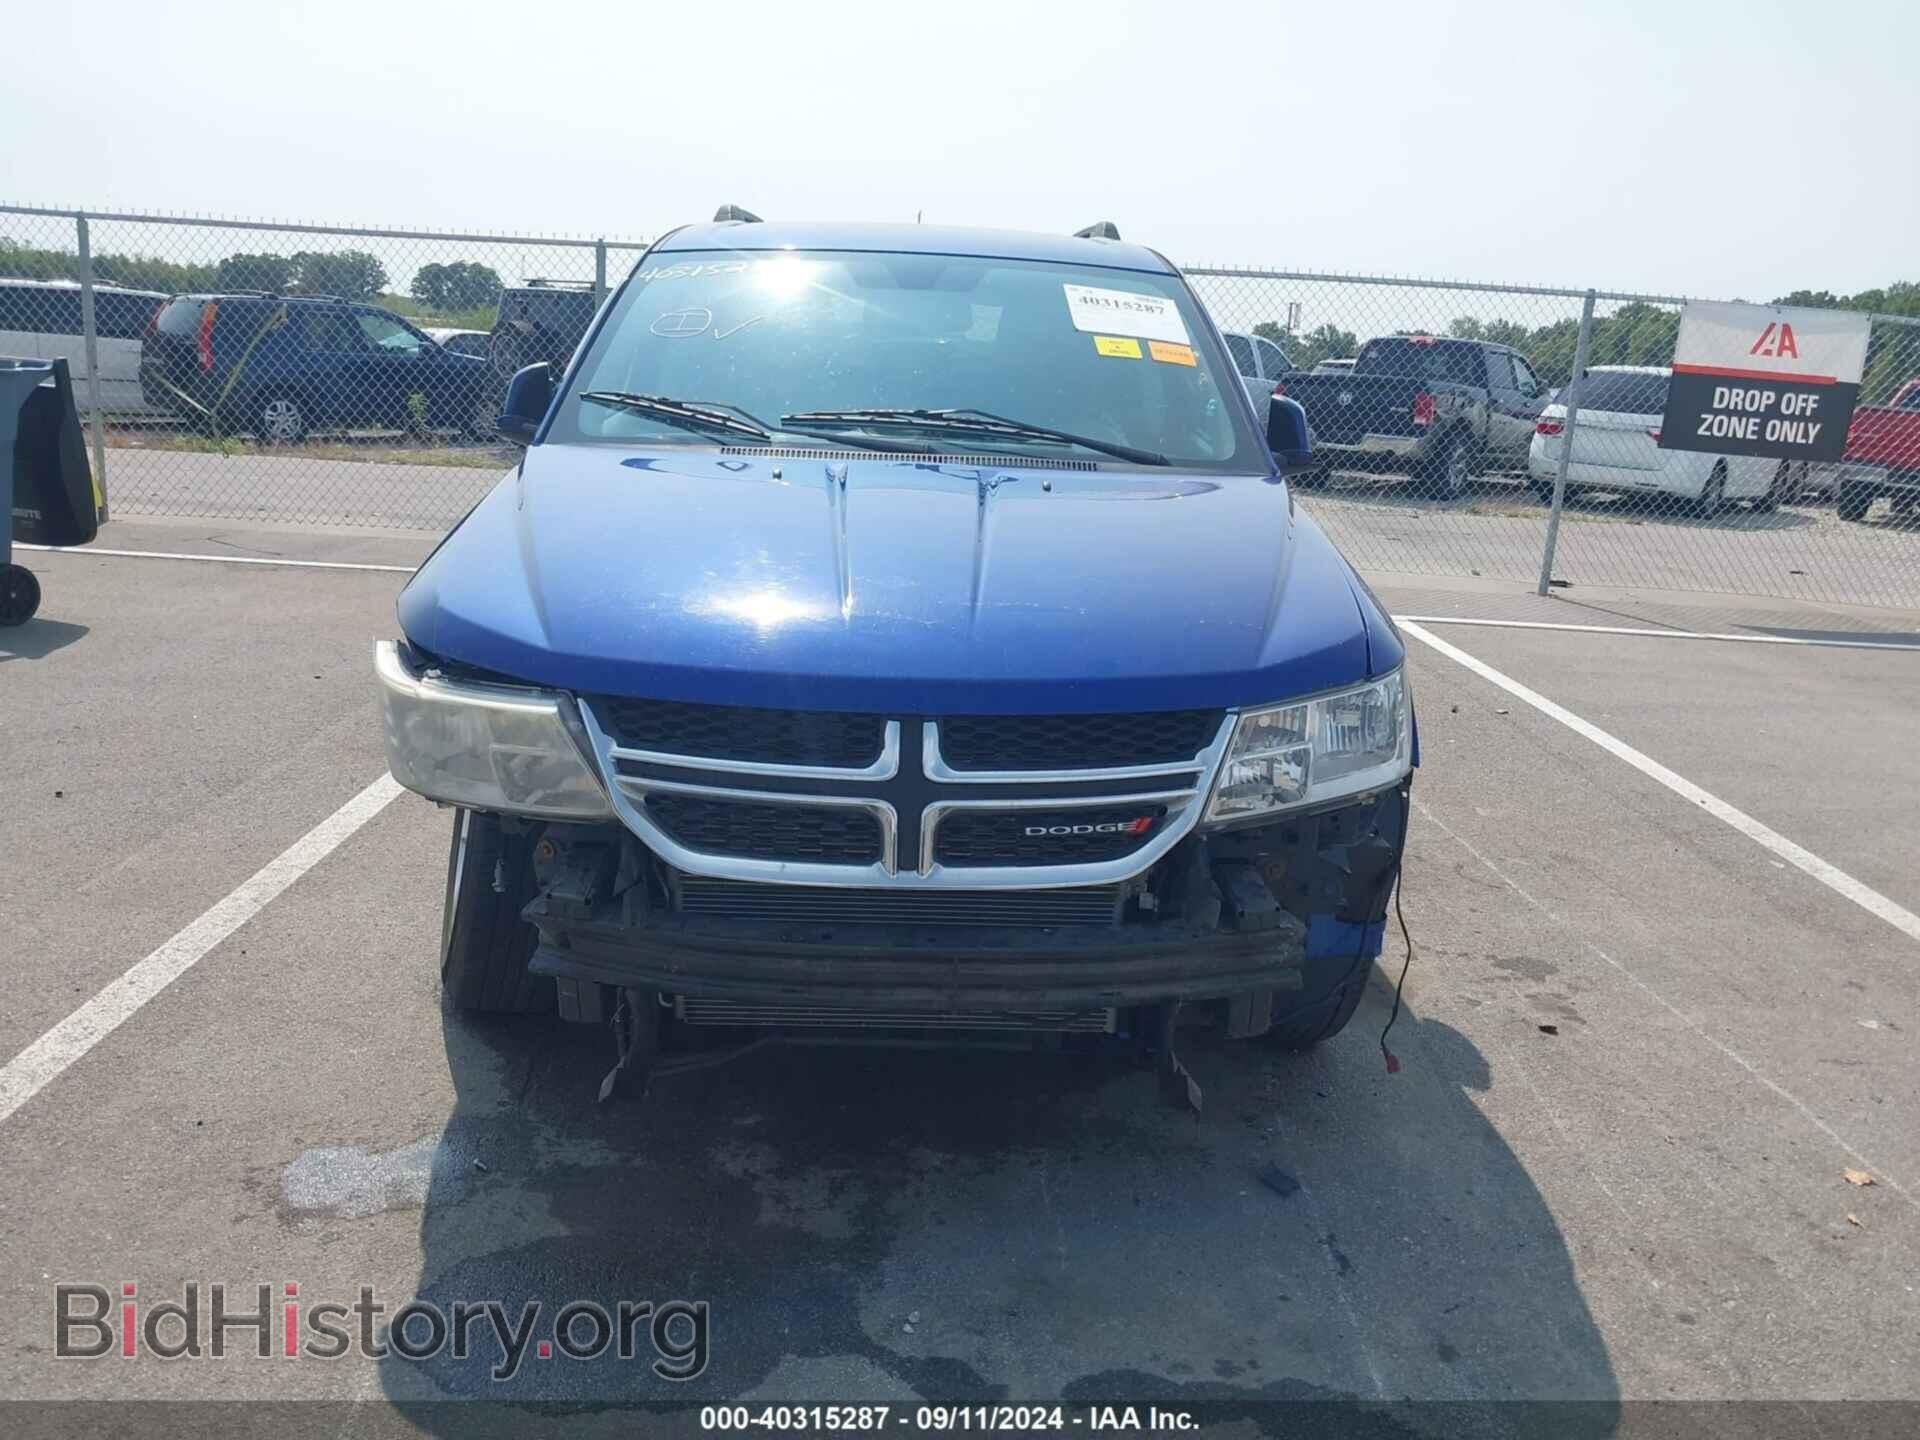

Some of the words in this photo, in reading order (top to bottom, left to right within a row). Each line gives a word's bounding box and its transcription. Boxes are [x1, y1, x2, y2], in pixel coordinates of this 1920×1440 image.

[1712, 386, 1776, 413] DROP
[1780, 391, 1820, 417] OFF
[1696, 413, 1760, 440] ZONE
[1765, 418, 1822, 445] ONLY
[1026, 822, 1137, 836] DODGE
